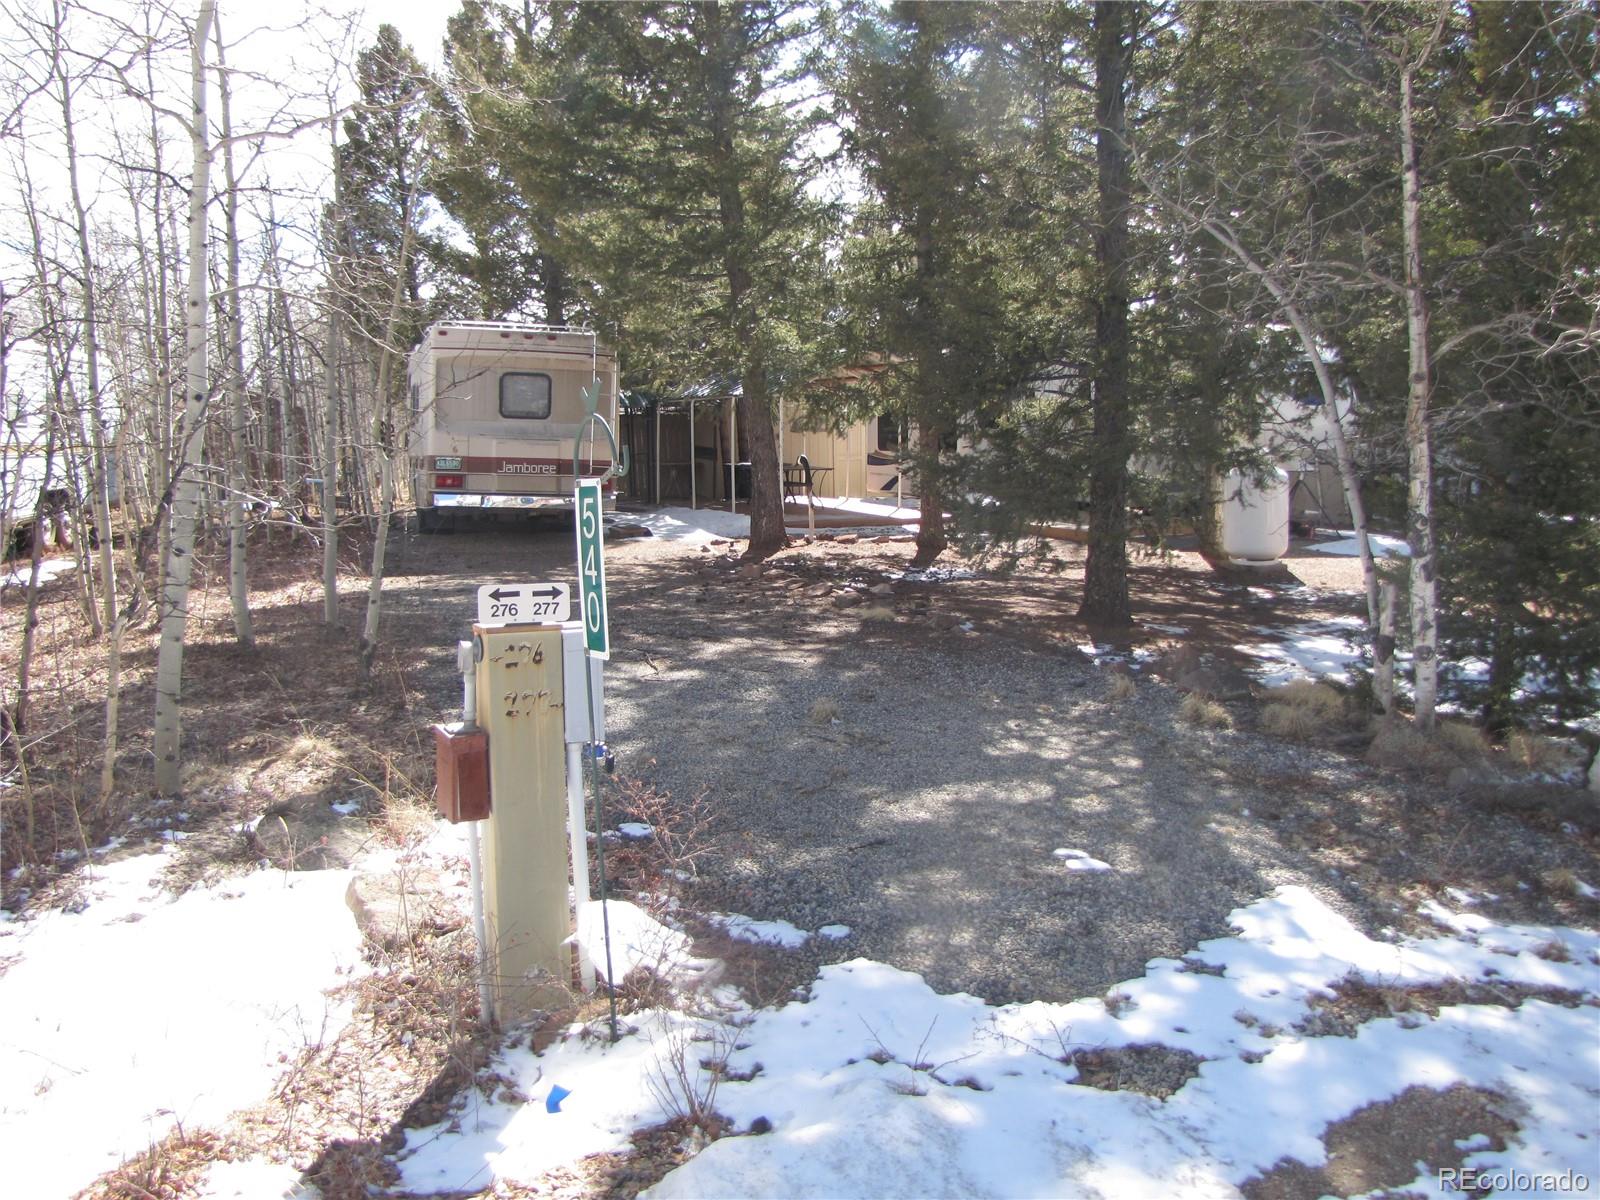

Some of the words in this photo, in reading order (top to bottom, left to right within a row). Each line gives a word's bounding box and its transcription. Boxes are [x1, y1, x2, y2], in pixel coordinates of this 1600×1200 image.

[497, 461, 557, 474] Jamboree
[583, 498, 600, 633] 540
[490, 603, 519, 618] 276
[533, 602, 560, 616] 277
